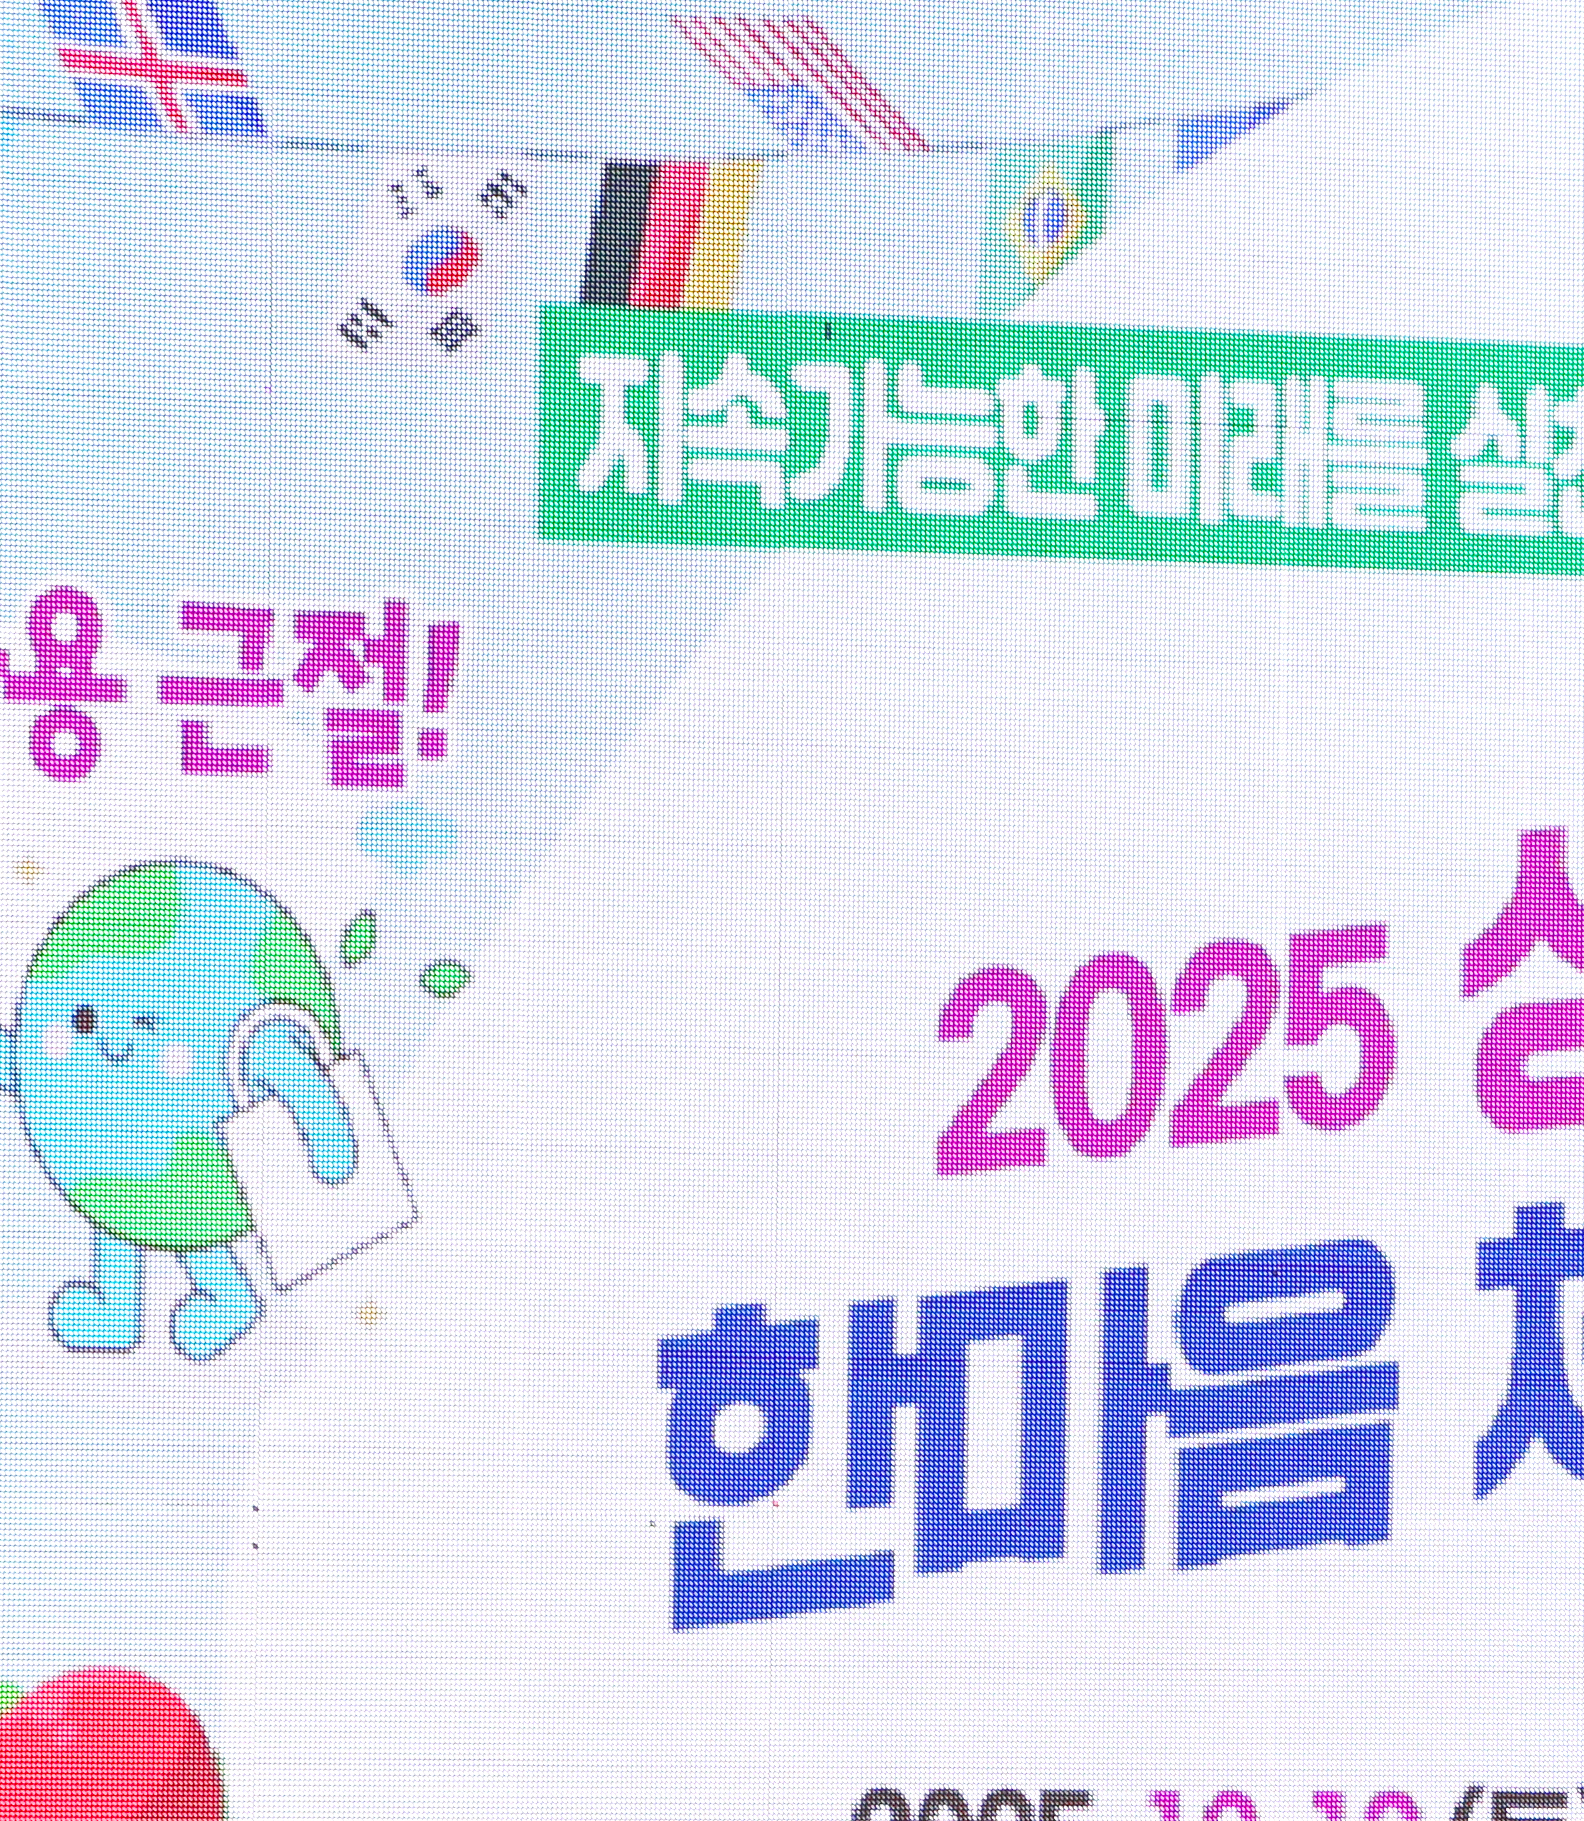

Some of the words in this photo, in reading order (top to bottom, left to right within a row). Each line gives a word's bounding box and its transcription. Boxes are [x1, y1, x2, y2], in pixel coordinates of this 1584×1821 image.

[575, 348, 1106, 524] 지속가능한
[1123, 369, 1430, 533] 미래를
[0, 584, 127, 783] 용
[157, 597, 460, 789] 근절!
[935, 922, 1399, 1178] 2025
[656, 1236, 1400, 1632] 한마음
